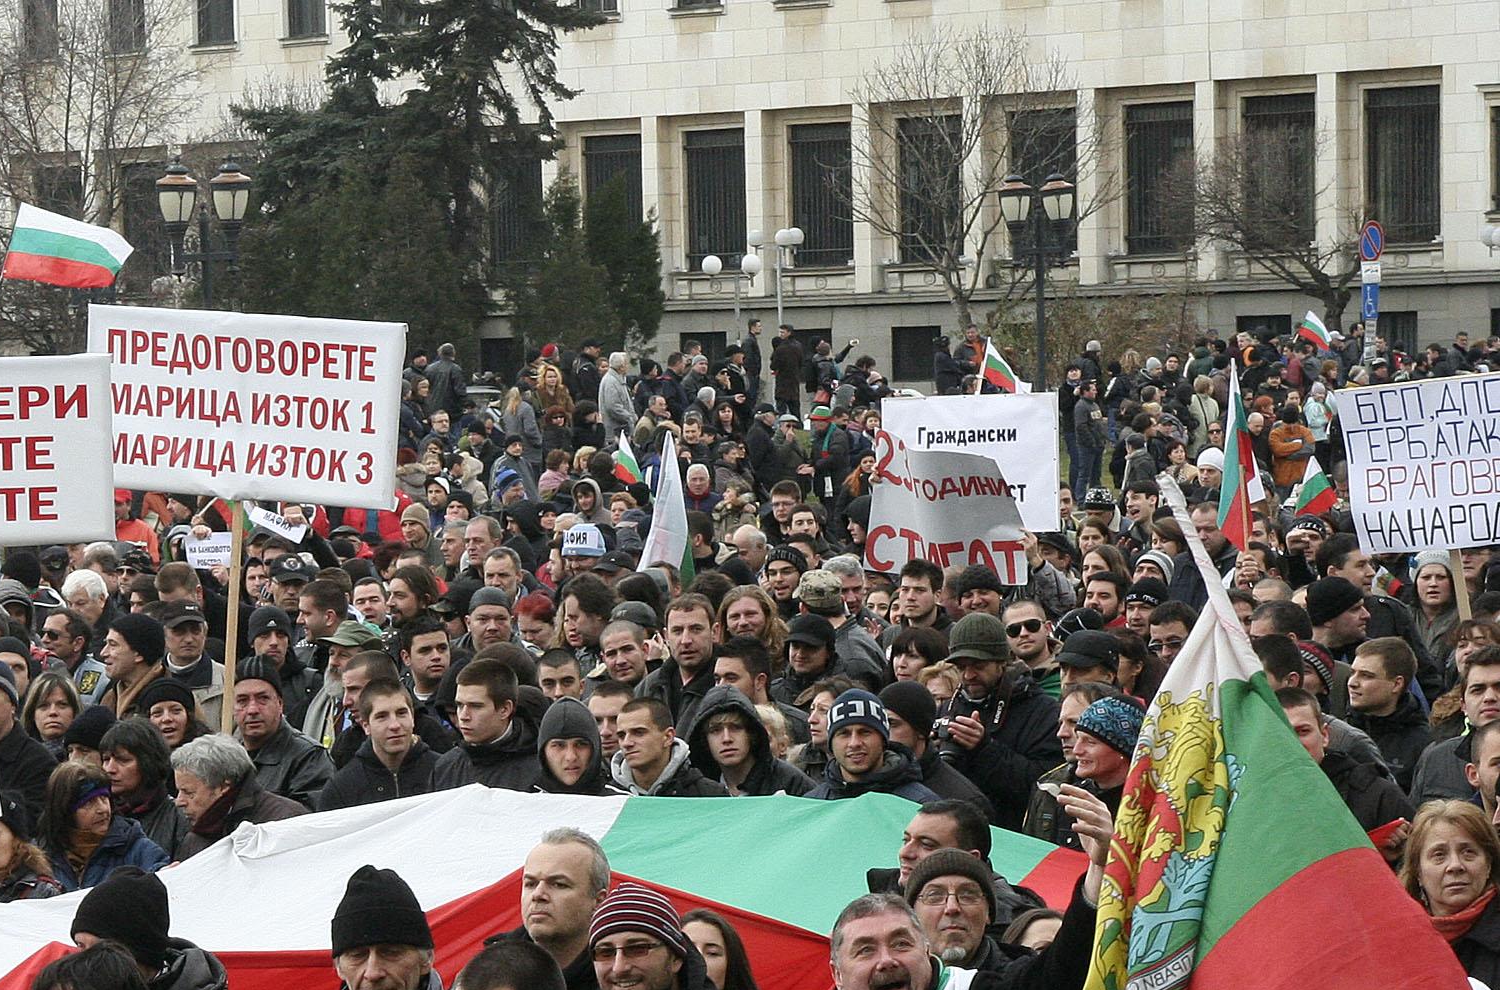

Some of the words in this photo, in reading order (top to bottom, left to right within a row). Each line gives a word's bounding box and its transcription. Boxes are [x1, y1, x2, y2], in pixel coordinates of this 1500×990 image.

[108, 328, 377, 382] ПРЕДОГОВОРЕТЕ
[111, 382, 243, 428] МАРИЦА
[251, 392, 350, 432] ИЗТОК
[360, 401, 376, 434] 1
[918, 426, 1017, 449] Граждански
[245, 442, 349, 484] ИЗТОК
[355, 451, 374, 485] 3
